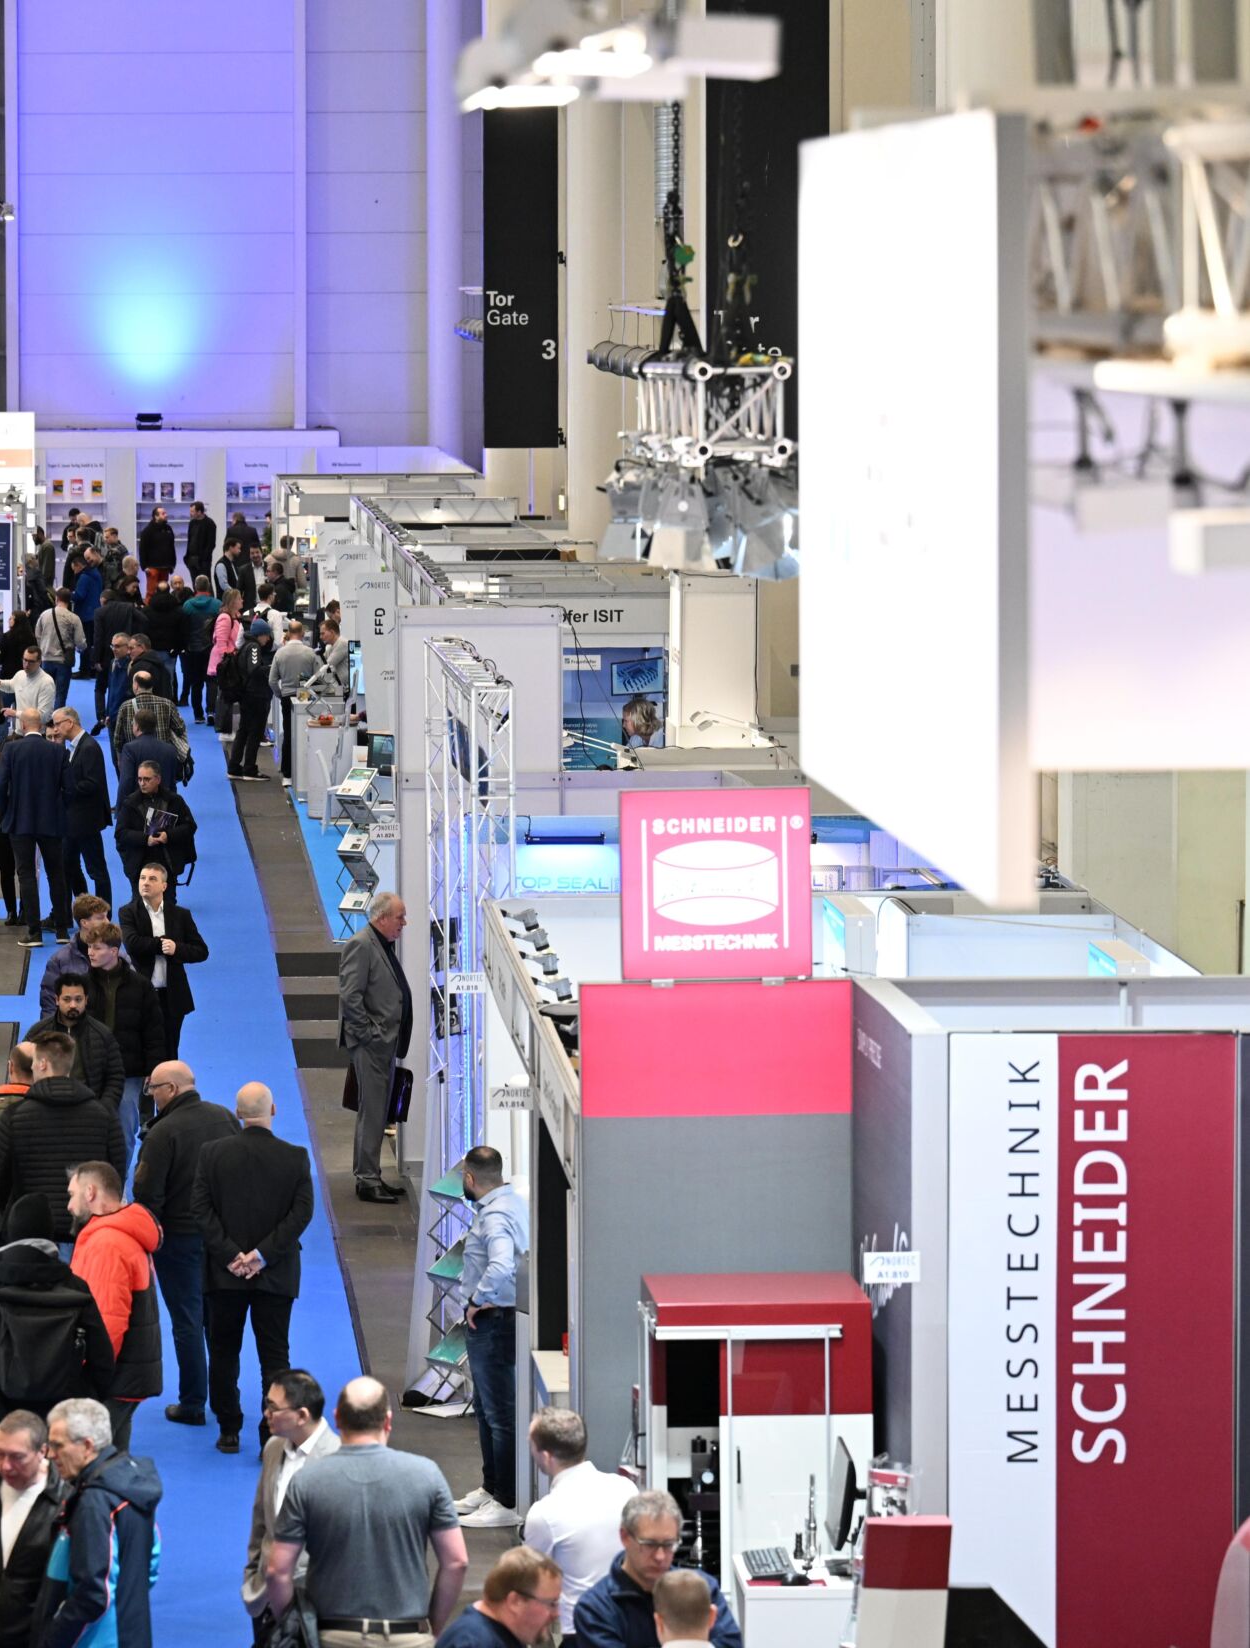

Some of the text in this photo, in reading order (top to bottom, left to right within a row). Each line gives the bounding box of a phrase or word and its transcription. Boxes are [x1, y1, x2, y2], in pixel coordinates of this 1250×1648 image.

[486, 291, 515, 306] Tor
[487, 309, 529, 325] Gate
[541, 339, 556, 360] 3
[374, 607, 386, 635] FFD
[593, 609, 625, 623] ISIT
[651, 815, 777, 835] SCHNEIDER
[514, 876, 610, 889] TOP SEAL
[653, 933, 779, 952] MESSTECHNIK
[461, 974, 484, 982] NORTEC
[505, 1089, 531, 1098] NORTEC
[1006, 1058, 1041, 1464] MESSTECHNIK
[1071, 1057, 1130, 1466] SCHNEIDER
[877, 1270, 909, 1279] A1.810
